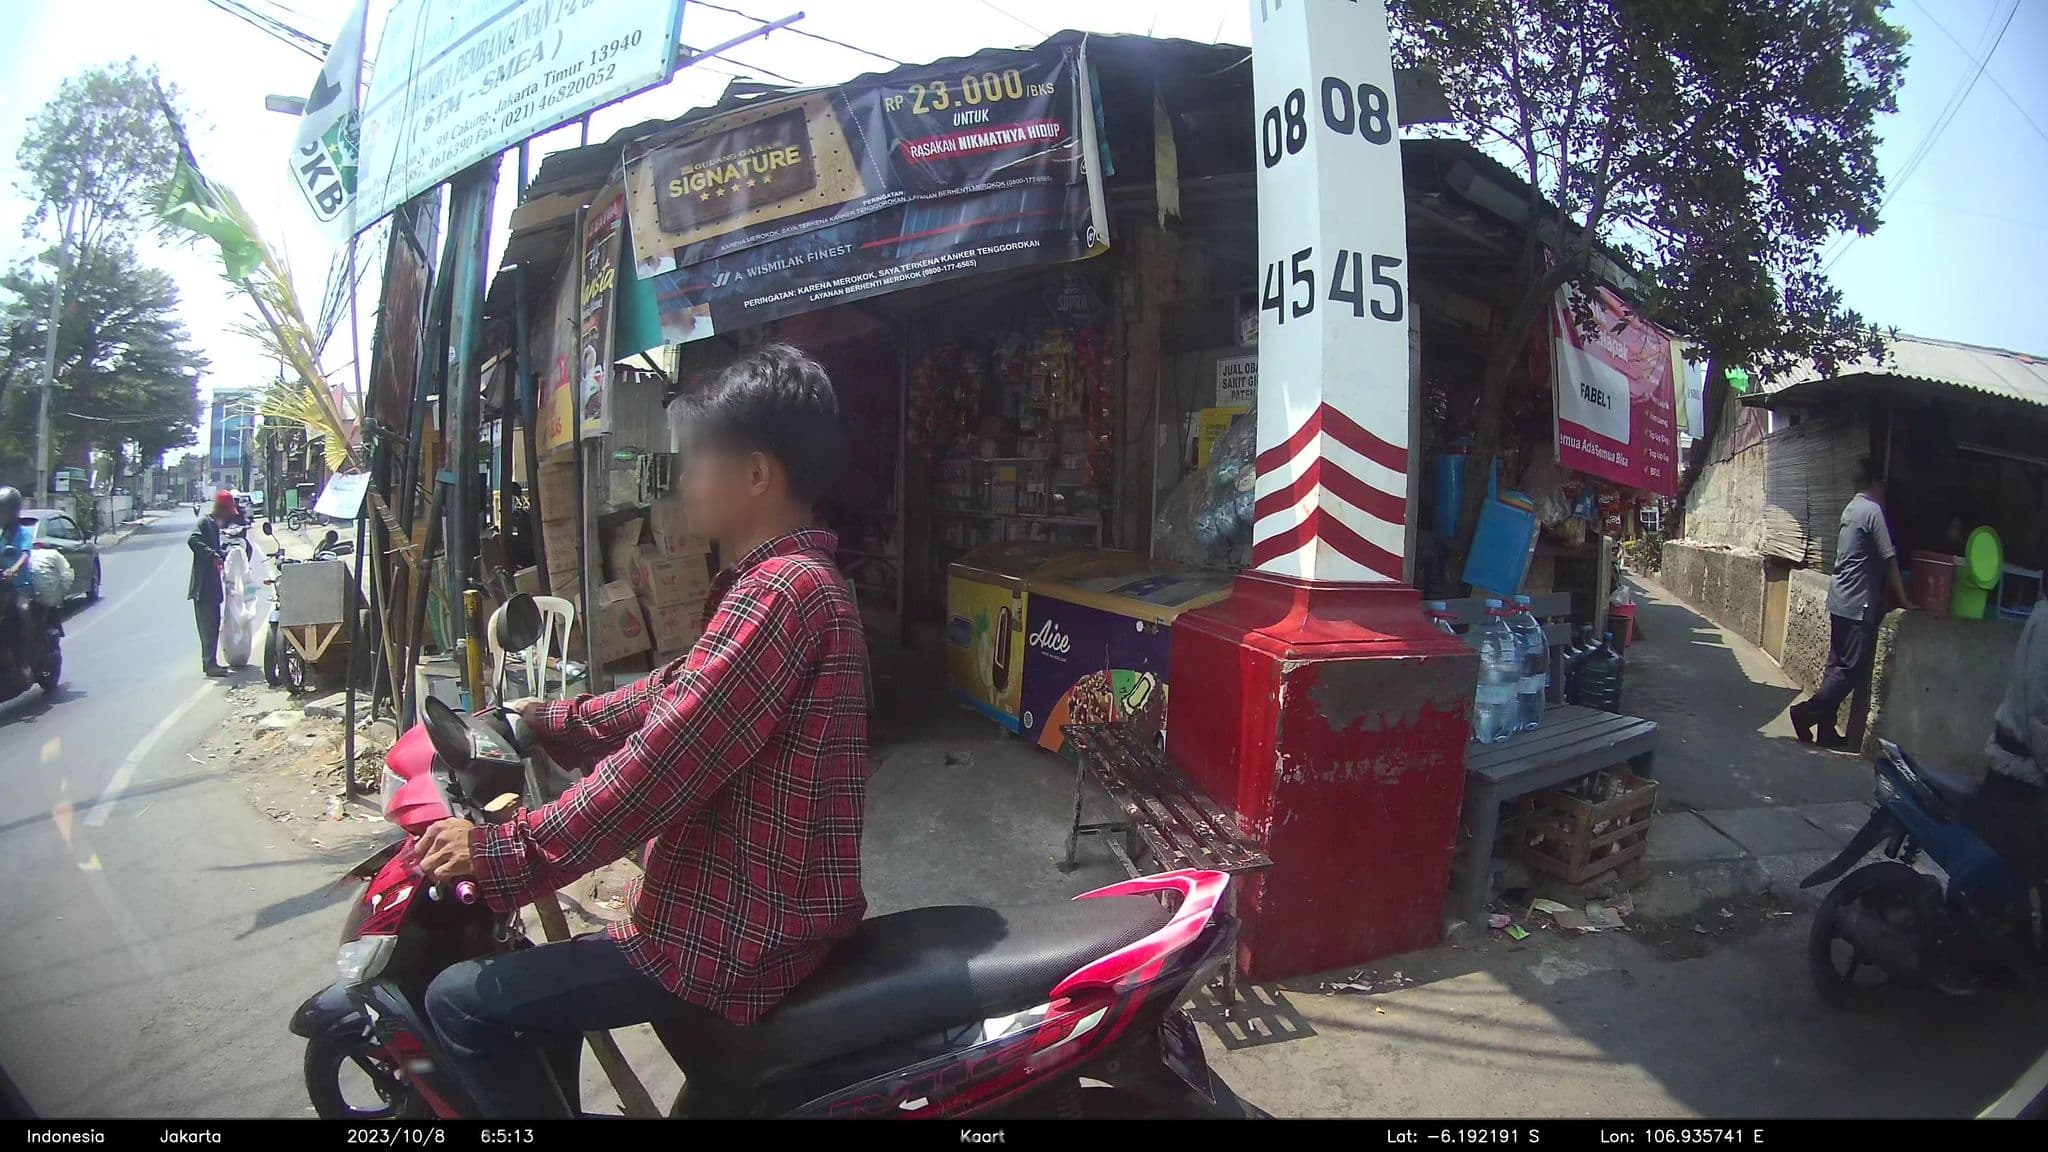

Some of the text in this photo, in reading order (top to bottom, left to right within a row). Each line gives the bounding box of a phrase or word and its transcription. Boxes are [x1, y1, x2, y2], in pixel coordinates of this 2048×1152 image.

[495, 82, 539, 115] Jakarta
[543, 60, 585, 88] Timur
[589, 29, 642, 67] 13940
[884, 69, 1055, 116] RP 23.000 /BKS
[501, 100, 535, 133] (021)
[538, 63, 616, 111] 46820052
[953, 108, 990, 127] UNTUK
[1320, 76, 1393, 146] 08
[910, 122, 1061, 159] RASAKAN NIKMATNYA HIDUP
[1262, 88, 1308, 169] 08
[669, 146, 801, 198] SIGNATURE
[862, 190, 904, 207] PERINGATAN
[734, 244, 853, 282] A WISMILAK FINEST
[744, 240, 1040, 308] PERINGATAN: KARENA MEROKOK, SAYA TERKENA KANKER TENGGOROKAN
[809, 259, 977, 302] LAYANAN BERHENTI MEROKOK (0800-177-6565)
[1261, 246, 1315, 325] 45
[1327, 249, 1404, 322] 45
[1222, 363, 1242, 376] JUAL
[1222, 376, 1246, 389] SAKIT
[1580, 382, 1612, 410] FABEL 1
[1029, 618, 1071, 654] Aice
